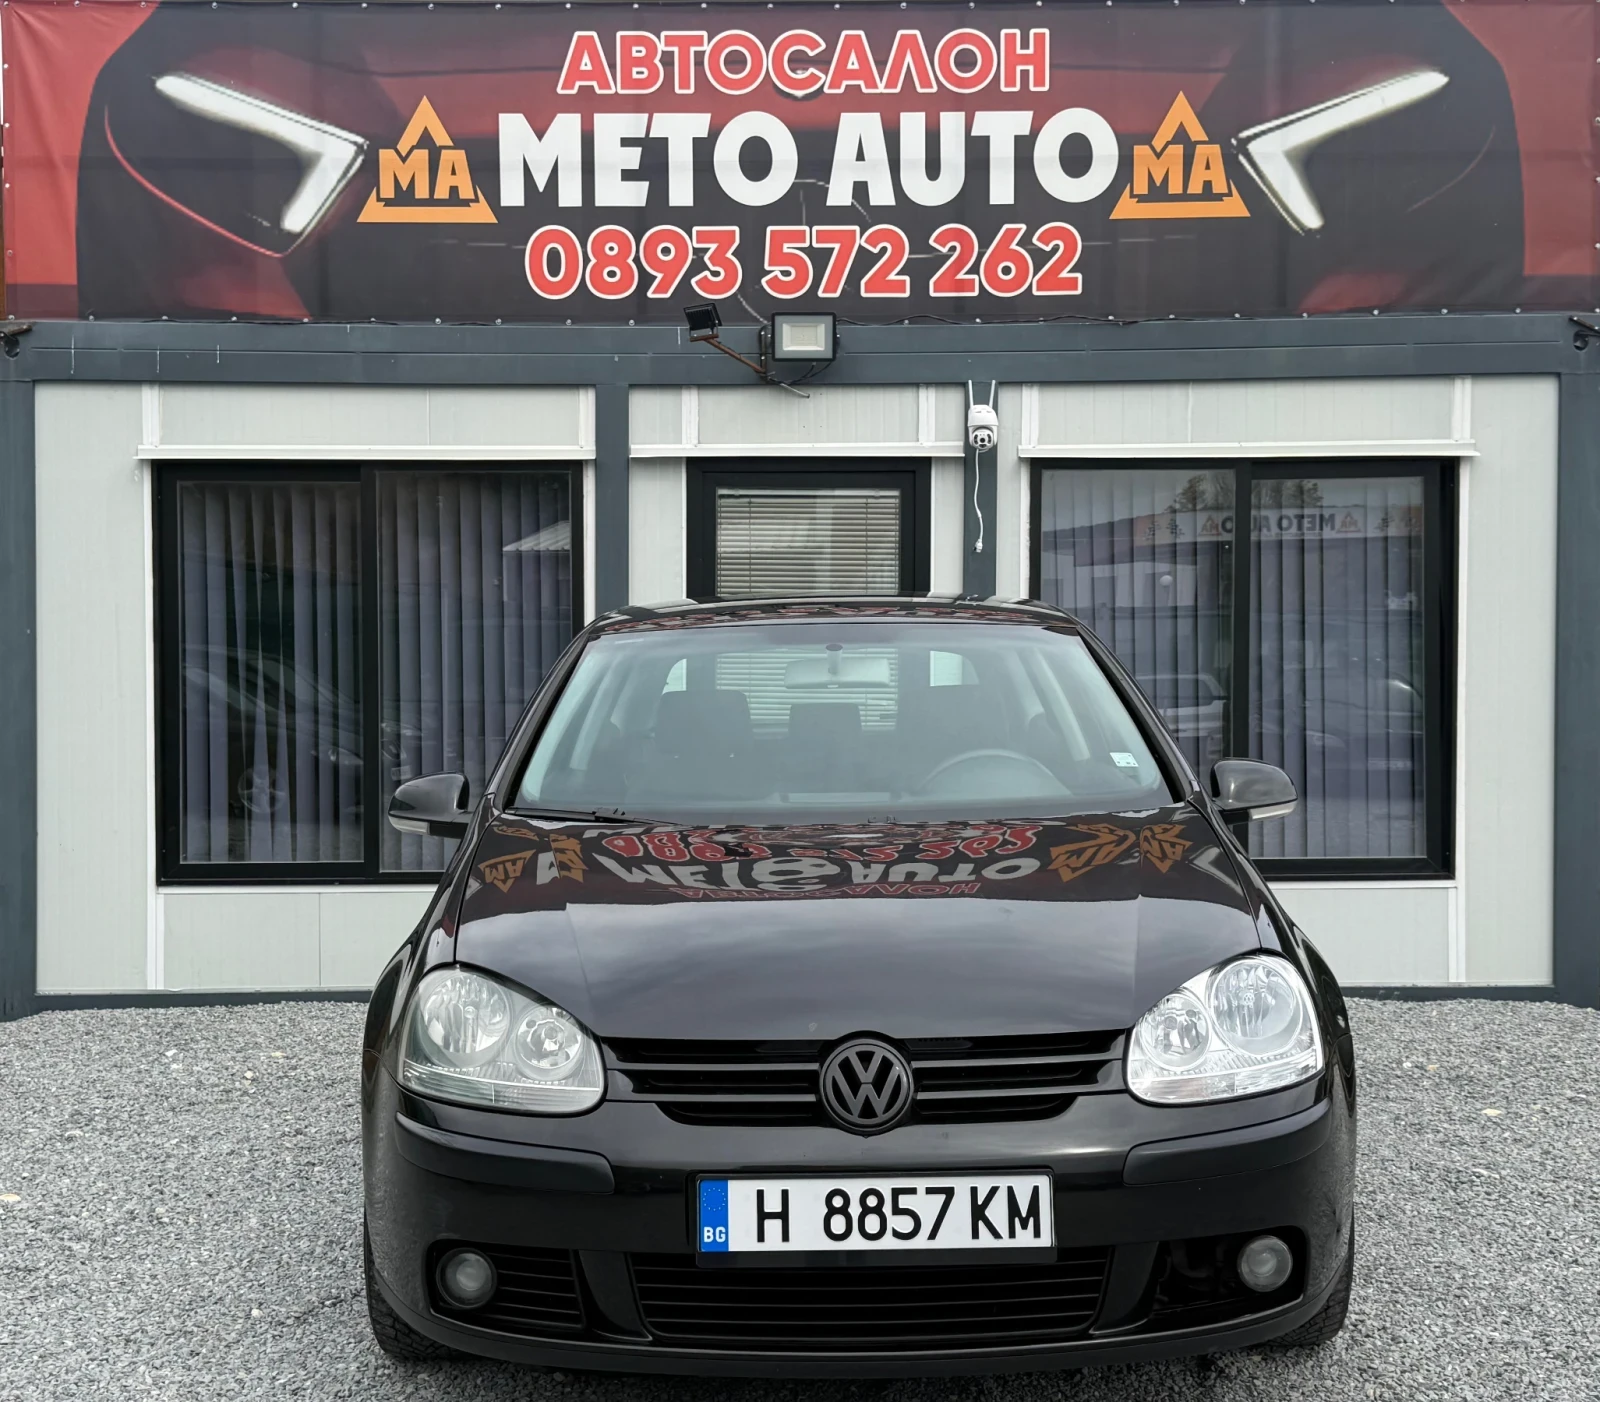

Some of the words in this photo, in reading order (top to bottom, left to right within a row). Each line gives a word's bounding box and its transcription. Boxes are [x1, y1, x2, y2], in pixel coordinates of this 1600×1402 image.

[556, 28, 1051, 96] АВТОСАЛОН
[498, 111, 799, 208] METO
[825, 107, 1119, 207] AUTO
[524, 225, 743, 300] 0893
[762, 223, 910, 299] 572
[927, 222, 1083, 297] 262
[703, 1226, 727, 1242] BG
[755, 1188, 790, 1243] H
[823, 1187, 956, 1242] 8857
[969, 1185, 1042, 1240] KM
